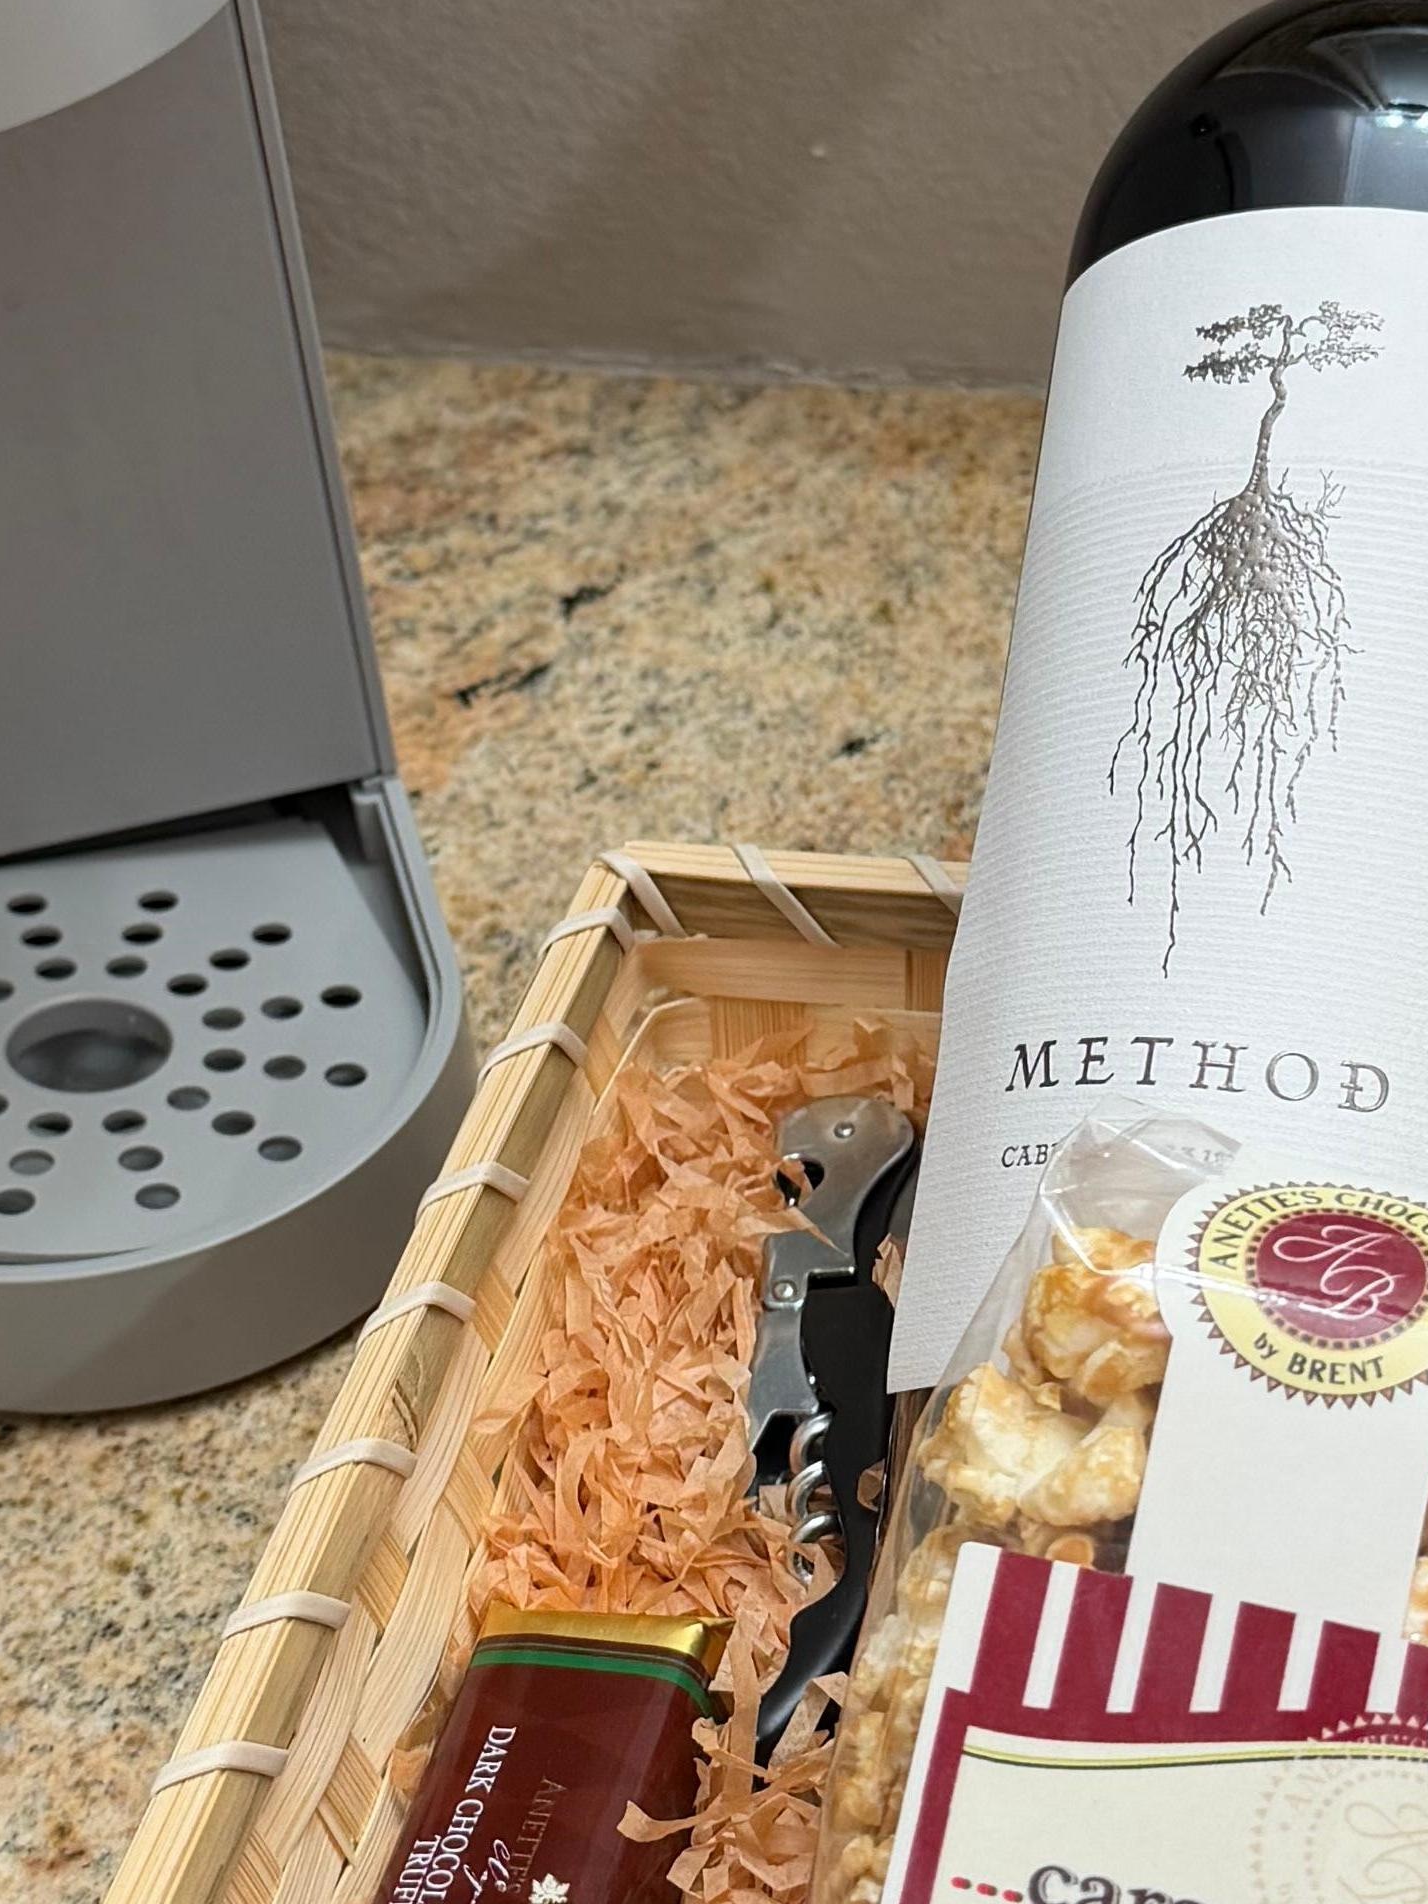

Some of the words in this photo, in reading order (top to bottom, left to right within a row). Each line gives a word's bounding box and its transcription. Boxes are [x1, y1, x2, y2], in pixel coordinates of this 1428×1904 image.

[1004, 1035, 1391, 1114] METHOD
[1207, 1189, 1324, 1271] ANETTE'S
[1252, 1331, 1281, 1360] by
[1286, 1351, 1384, 1386] BRENT
[464, 1724, 517, 1795] DARK
